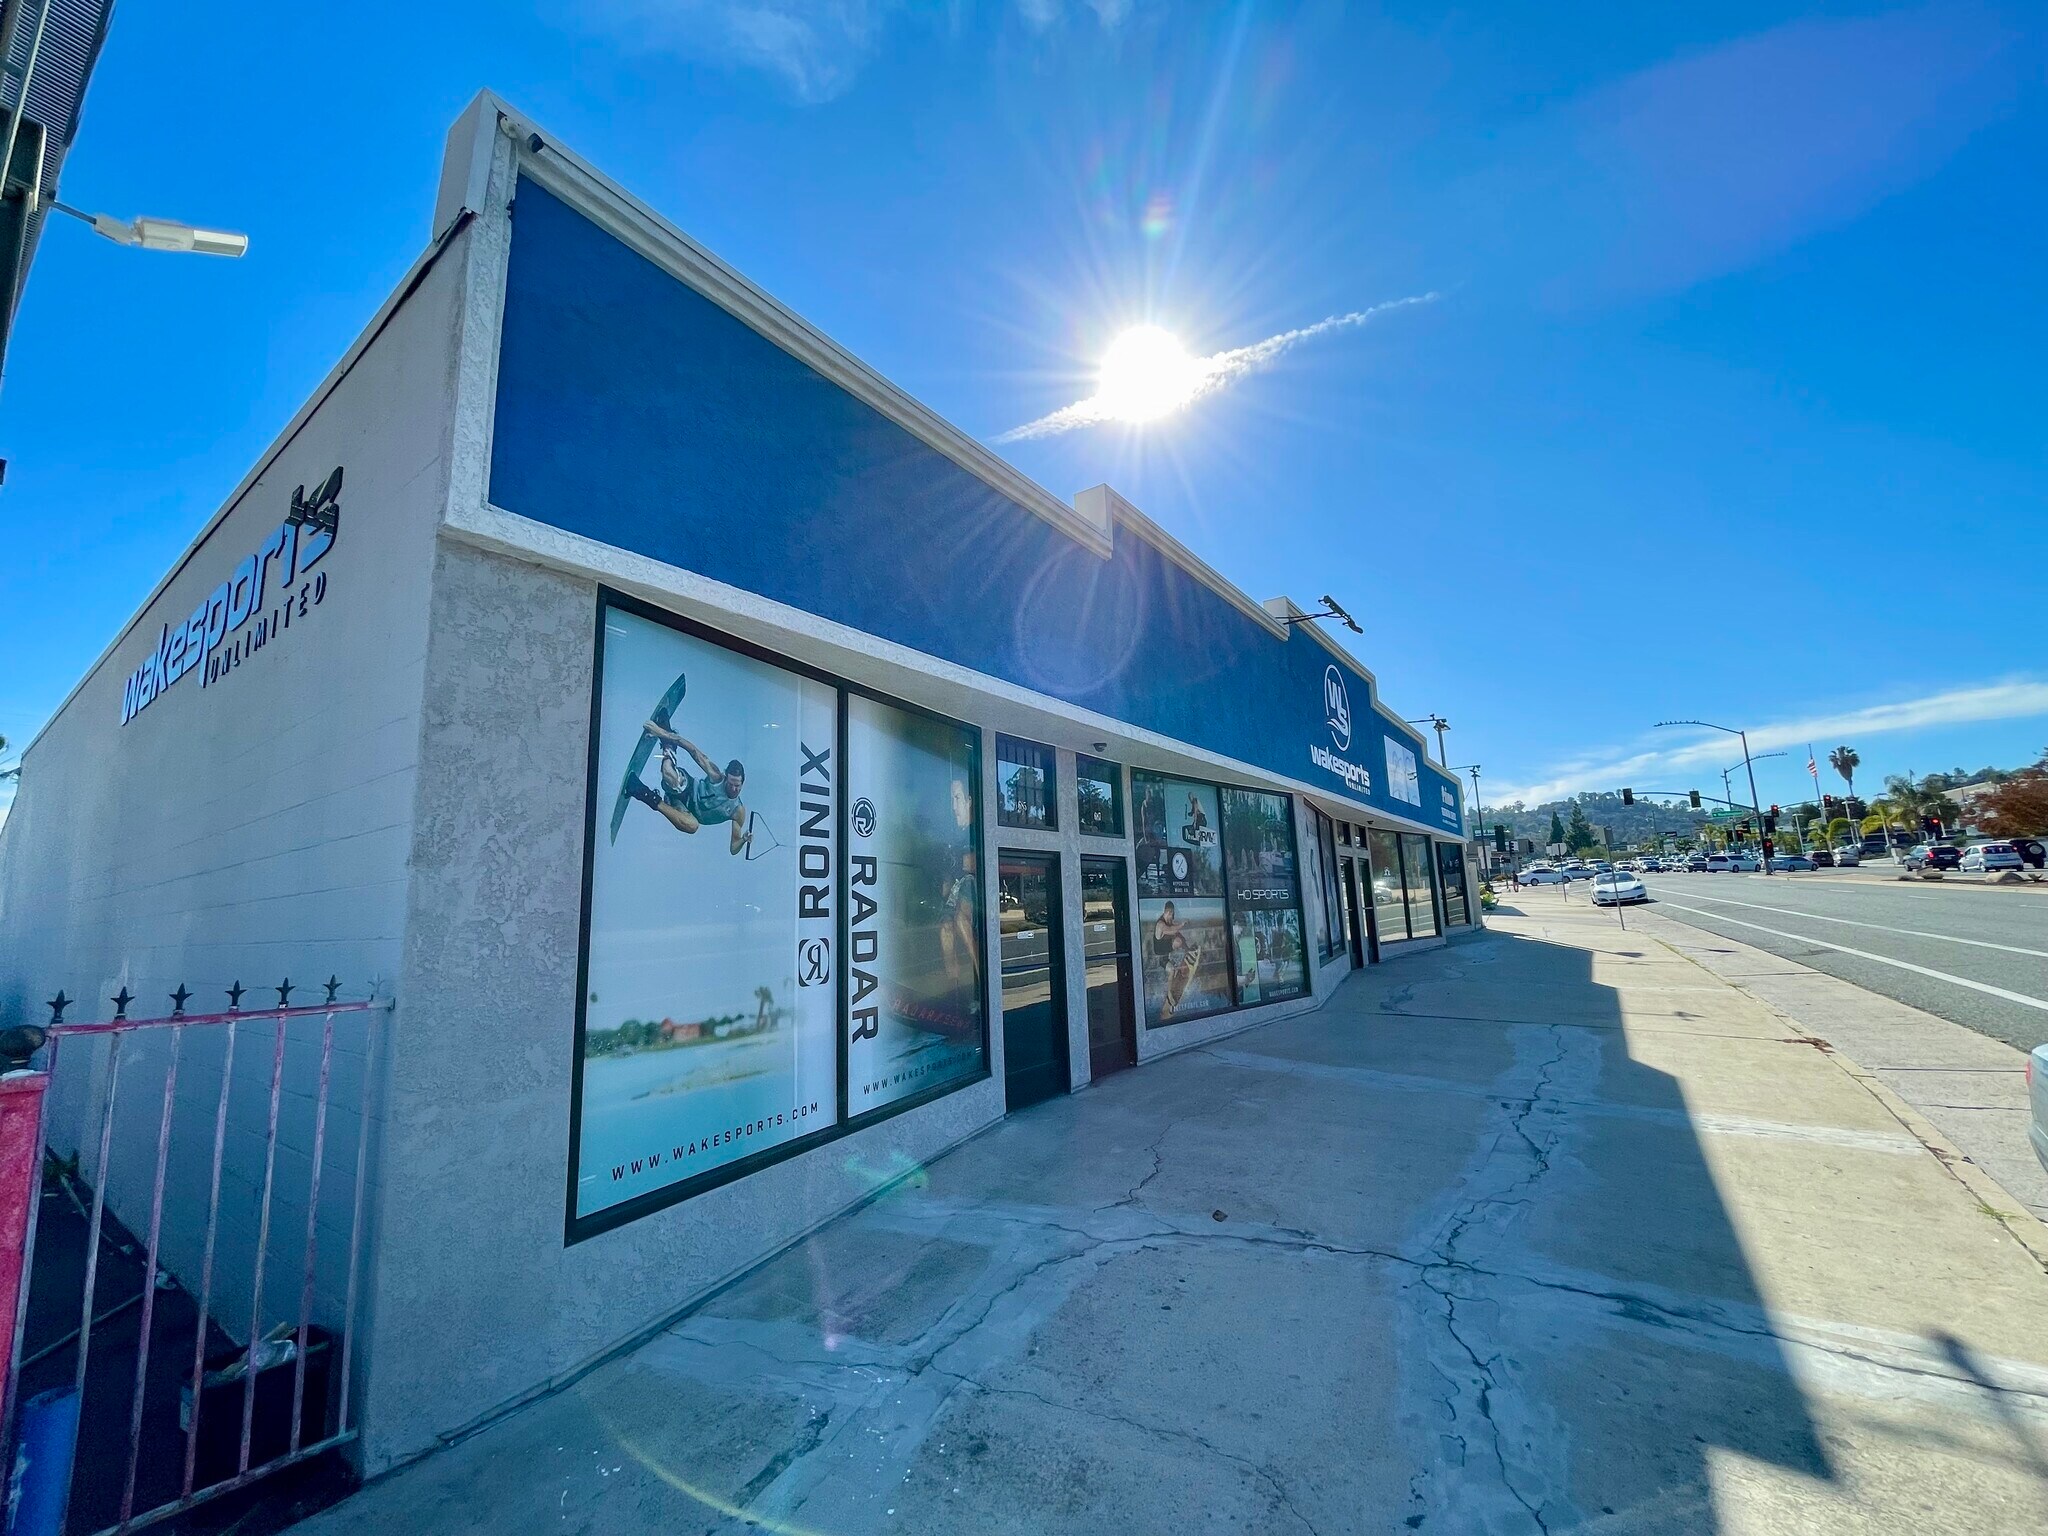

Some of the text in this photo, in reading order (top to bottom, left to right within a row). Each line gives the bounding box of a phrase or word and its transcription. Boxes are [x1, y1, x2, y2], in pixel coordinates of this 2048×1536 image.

[211, 571, 326, 683] UNLIMITED
[799, 741, 831, 919] RONIX
[851, 855, 880, 1045] RADAR
[1237, 889, 1289, 900] HO SPORTS
[612, 1101, 819, 1181] WWW.WAKESPORTS.COM
